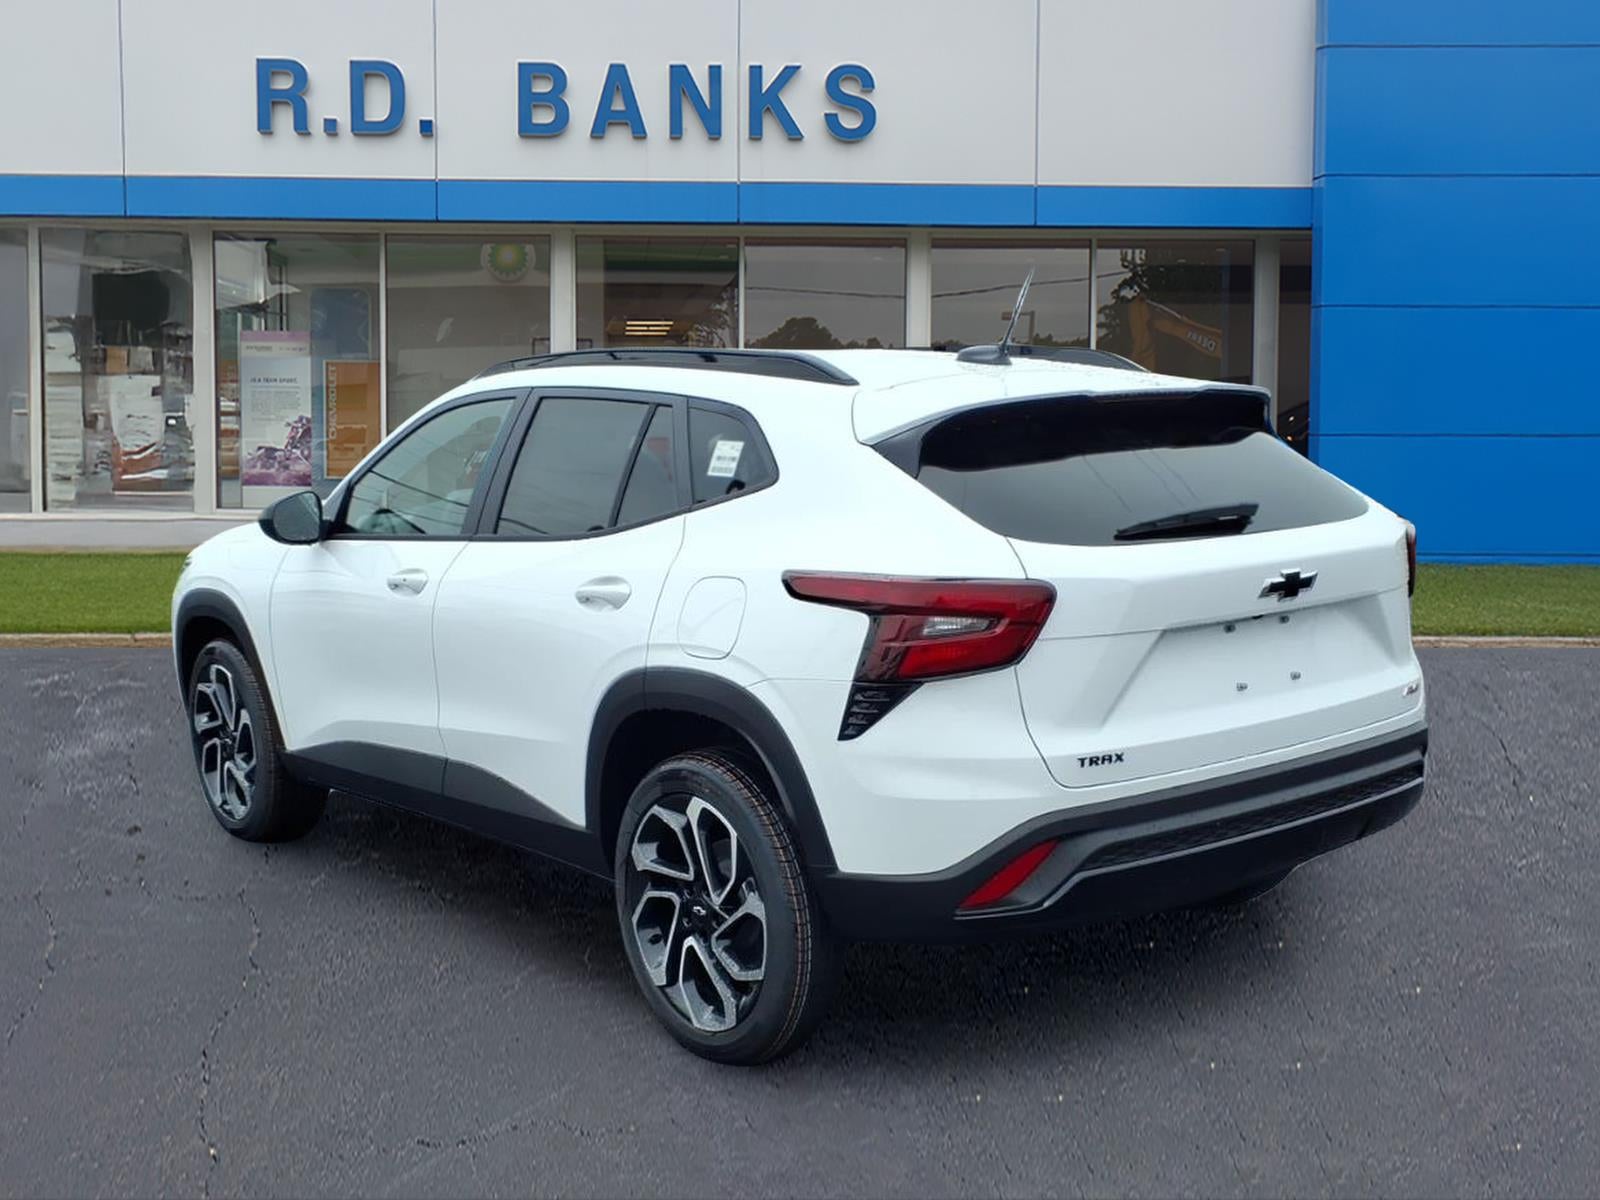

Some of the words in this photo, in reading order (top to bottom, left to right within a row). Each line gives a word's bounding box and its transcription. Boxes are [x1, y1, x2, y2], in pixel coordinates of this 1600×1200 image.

[256, 57, 434, 135] R.D.
[517, 62, 878, 142] BANKS
[1078, 753, 1124, 768] TRAX
